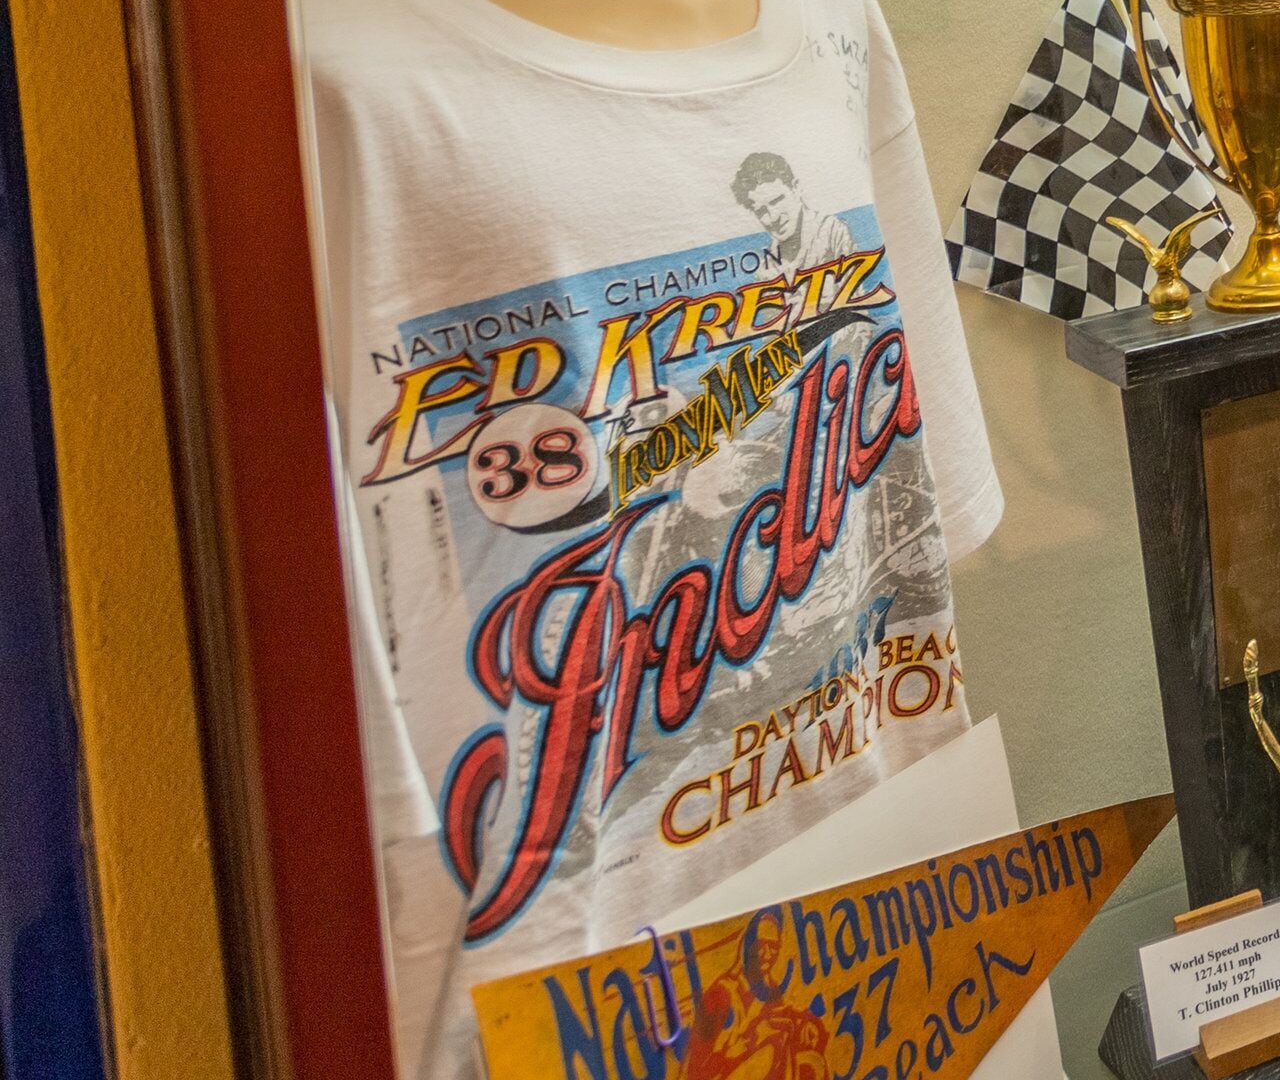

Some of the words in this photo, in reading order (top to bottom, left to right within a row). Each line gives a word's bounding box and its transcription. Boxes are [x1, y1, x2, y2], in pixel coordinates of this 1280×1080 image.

[369, 293, 590, 375] NATIONAL
[603, 243, 785, 306] CHAMPION
[360, 336, 565, 488] ED
[578, 246, 898, 420] KRETZ
[475, 429, 586, 502] 38
[732, 662, 869, 761] DAYTONA
[741, 818, 1102, 1004] Championship
[1170, 953, 1205, 973] World
[1207, 942, 1240, 966] Speed
[1243, 928, 1280, 949] Record
[1194, 961, 1234, 983] 127.411
[1238, 952, 1262, 973] mph
[1205, 979, 1228, 995] July
[1232, 968, 1256, 986] 1927
[1178, 1006, 1192, 1021] T.
[1195, 991, 1240, 1016] Clinton
